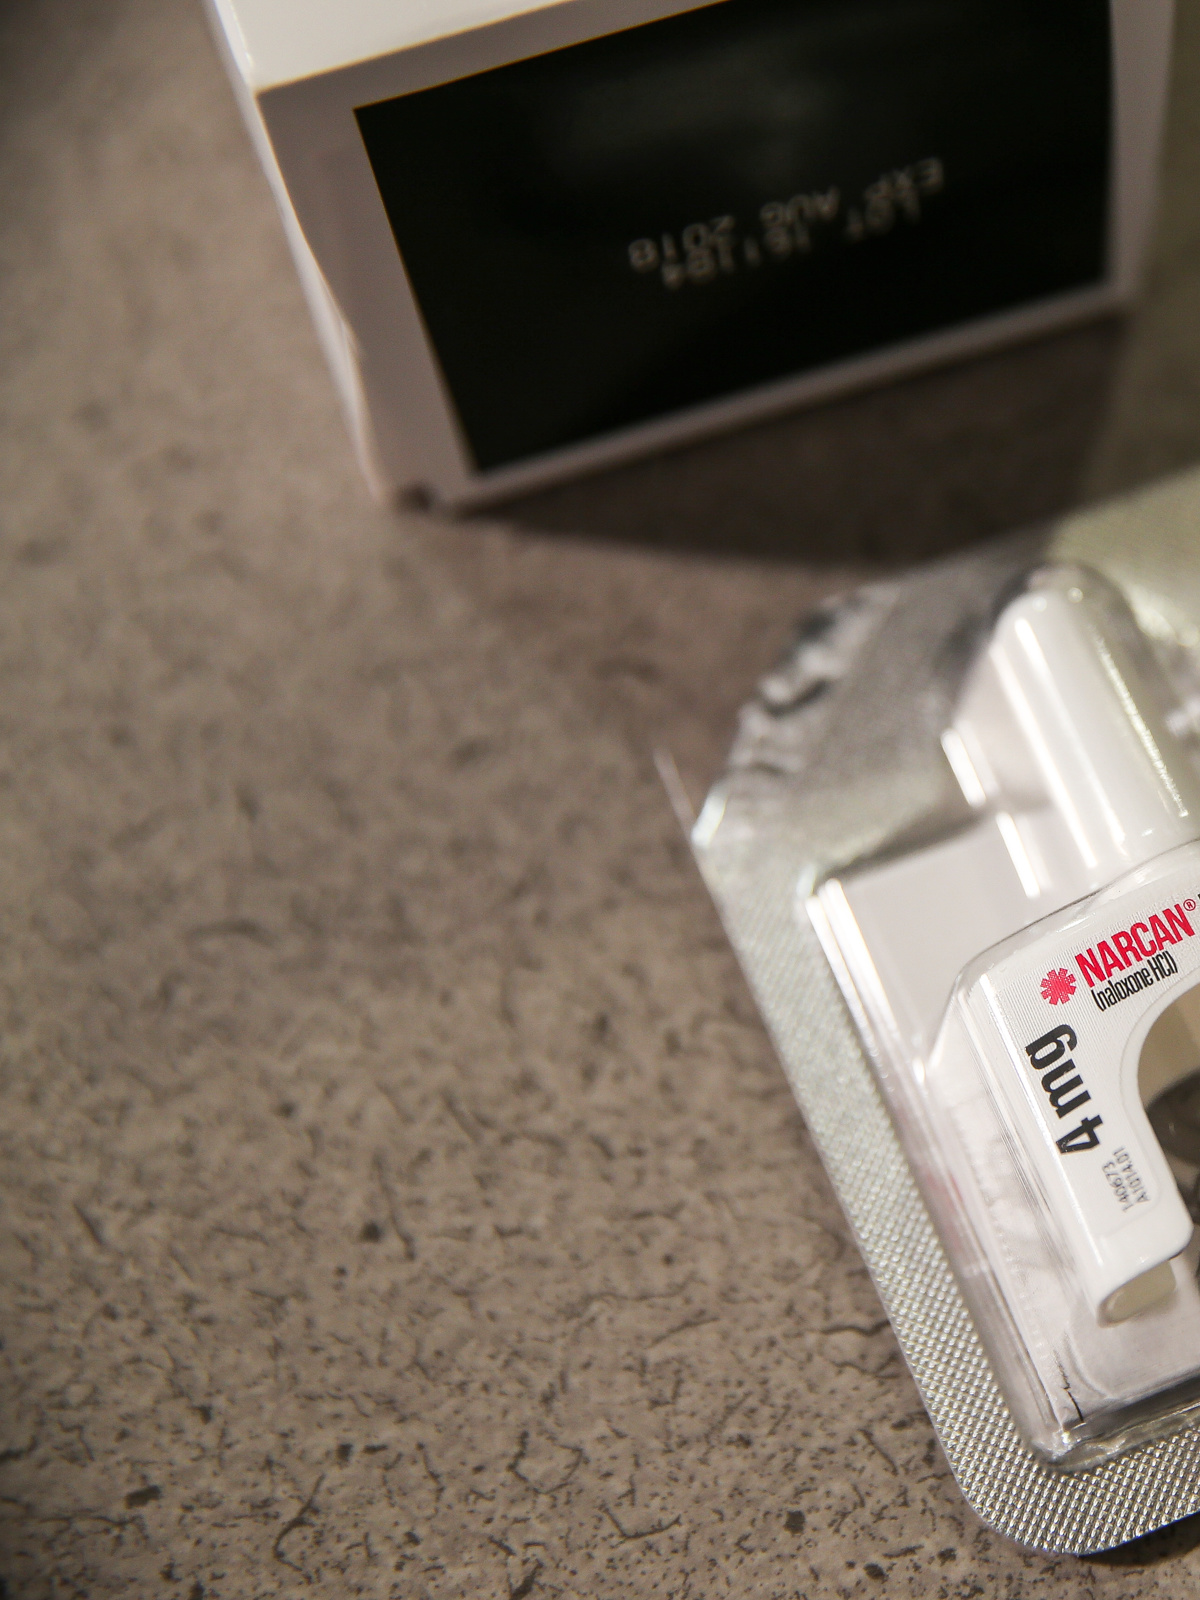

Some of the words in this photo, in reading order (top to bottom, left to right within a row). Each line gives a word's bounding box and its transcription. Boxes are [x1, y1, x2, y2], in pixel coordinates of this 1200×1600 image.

[864, 156, 945, 206] EXP
[760, 187, 840, 228] AUG
[1090, 972, 1154, 1012] (naloxone
[1024, 1023, 1092, 1119] mg
[1055, 1114, 1103, 1155] 4
[1102, 1161, 1134, 1211] 140673
